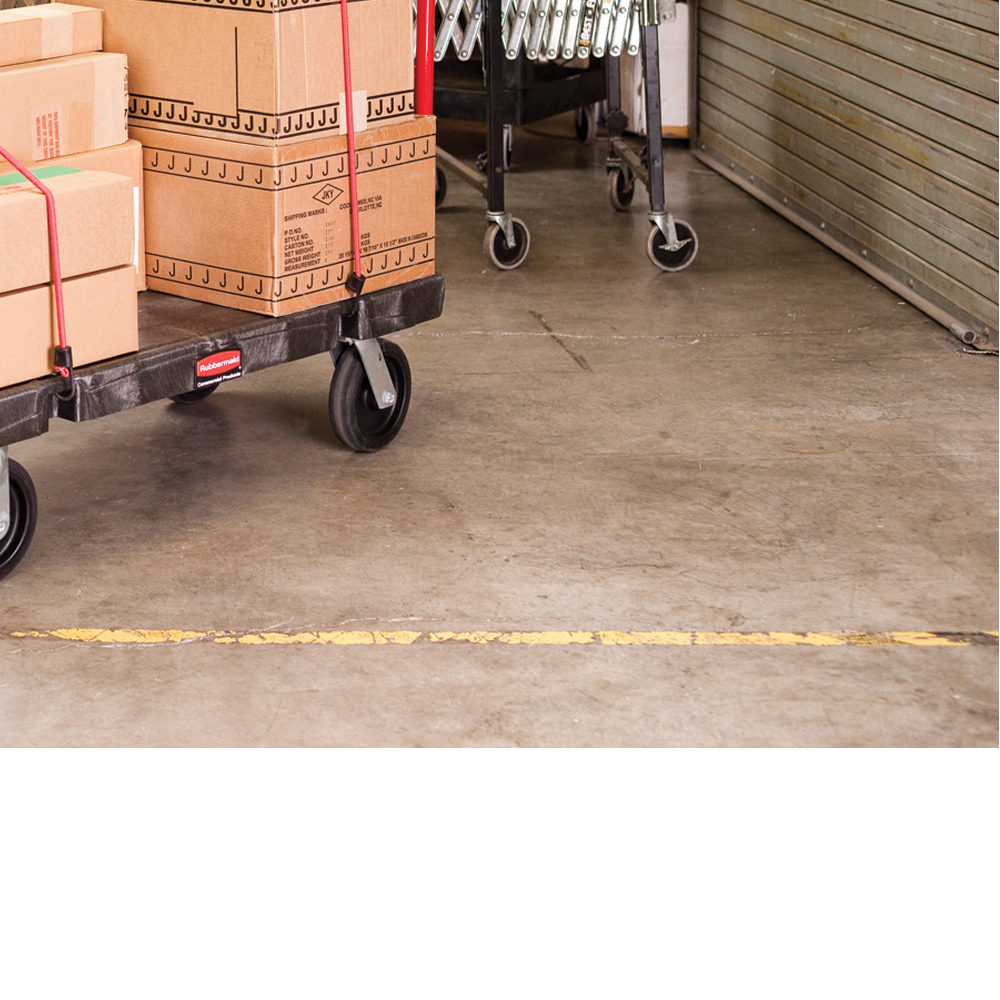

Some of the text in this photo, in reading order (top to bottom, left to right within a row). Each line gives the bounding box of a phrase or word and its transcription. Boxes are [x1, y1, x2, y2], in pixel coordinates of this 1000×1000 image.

[322, 189, 334, 200] JKY
[284, 208, 325, 222] SHIPPING MARKS
[284, 235, 299, 244] STYLE
[284, 241, 304, 250] CARTON
[295, 246, 314, 255] WEIGHT
[284, 251, 321, 265] GROSS WEIGHT
[284, 258, 321, 272] MEASUREMENT
[200, 355, 240, 372] Rubbermaid
